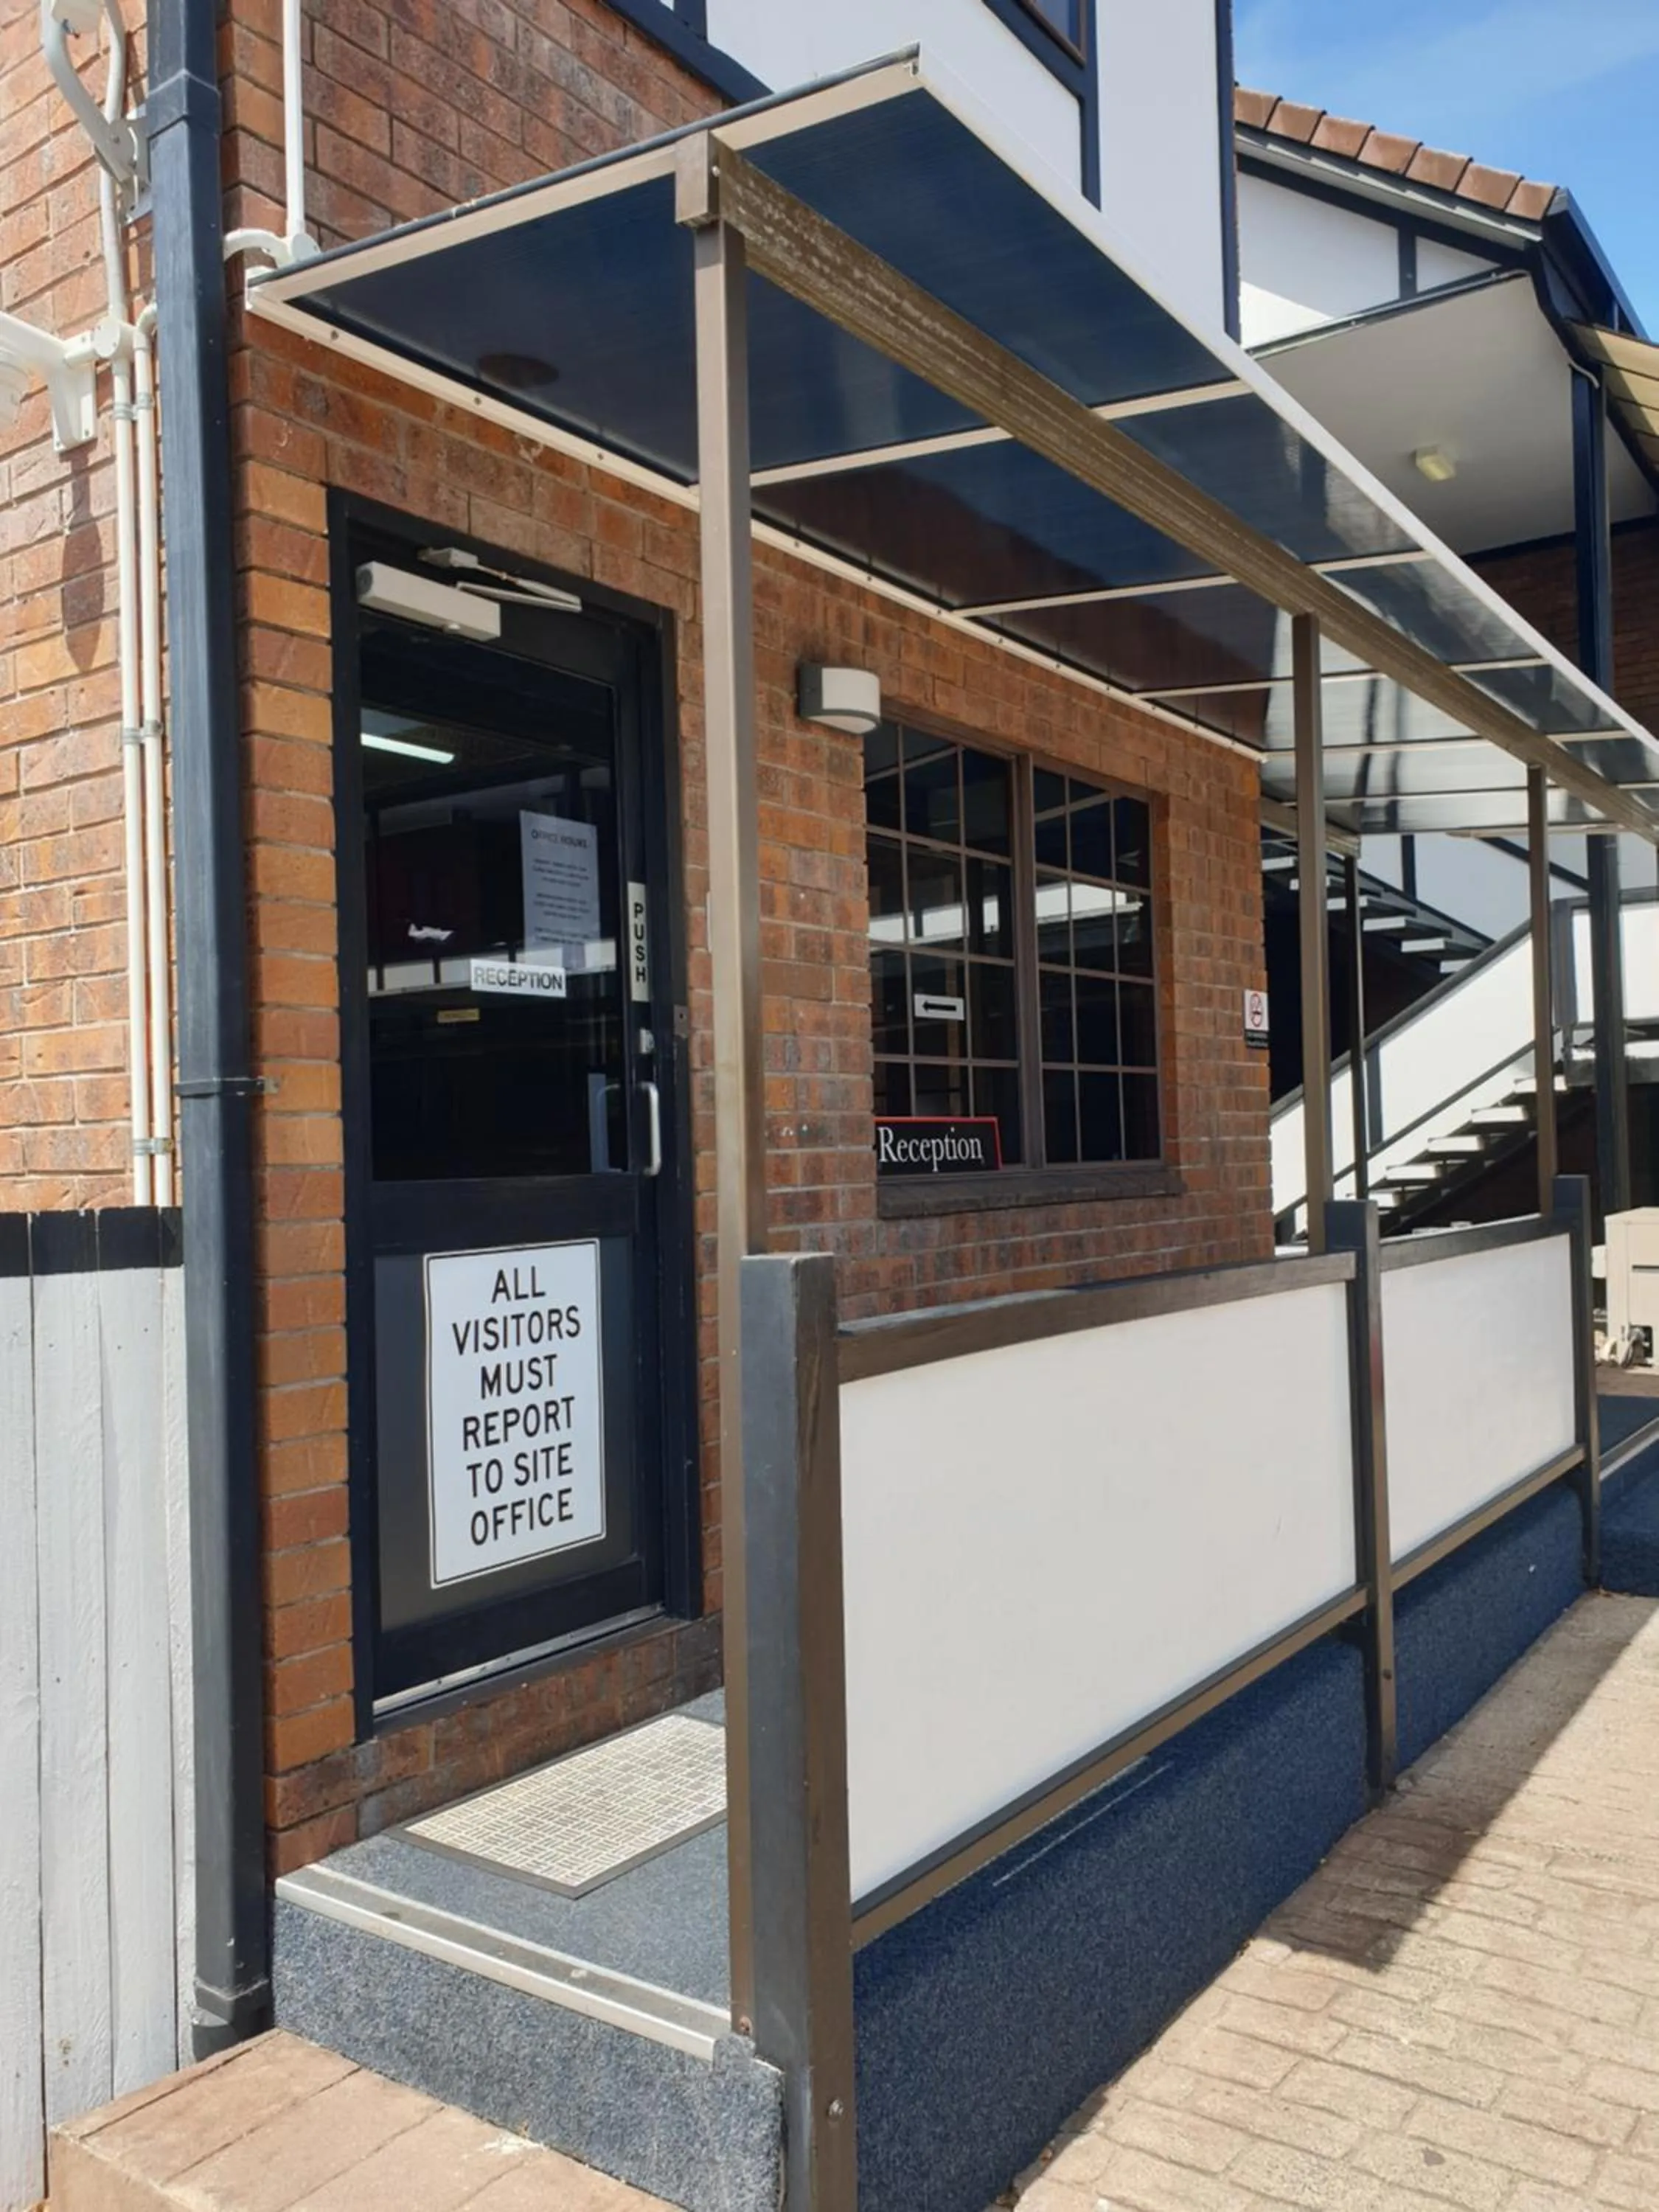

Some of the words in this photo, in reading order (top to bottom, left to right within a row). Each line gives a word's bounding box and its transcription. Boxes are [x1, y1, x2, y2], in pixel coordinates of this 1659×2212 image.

[633, 902, 646, 983] PUSH
[473, 967, 563, 990] RECEPTION
[877, 1126, 983, 1172] Reception
[491, 1265, 546, 1304] ALL
[452, 1305, 581, 1355] VISITORS
[481, 1354, 558, 1399] MUST
[463, 1396, 575, 1451] REPORT
[467, 1458, 503, 1498] TO
[514, 1442, 573, 1486] SITE
[470, 1487, 574, 1546] OFFICE
